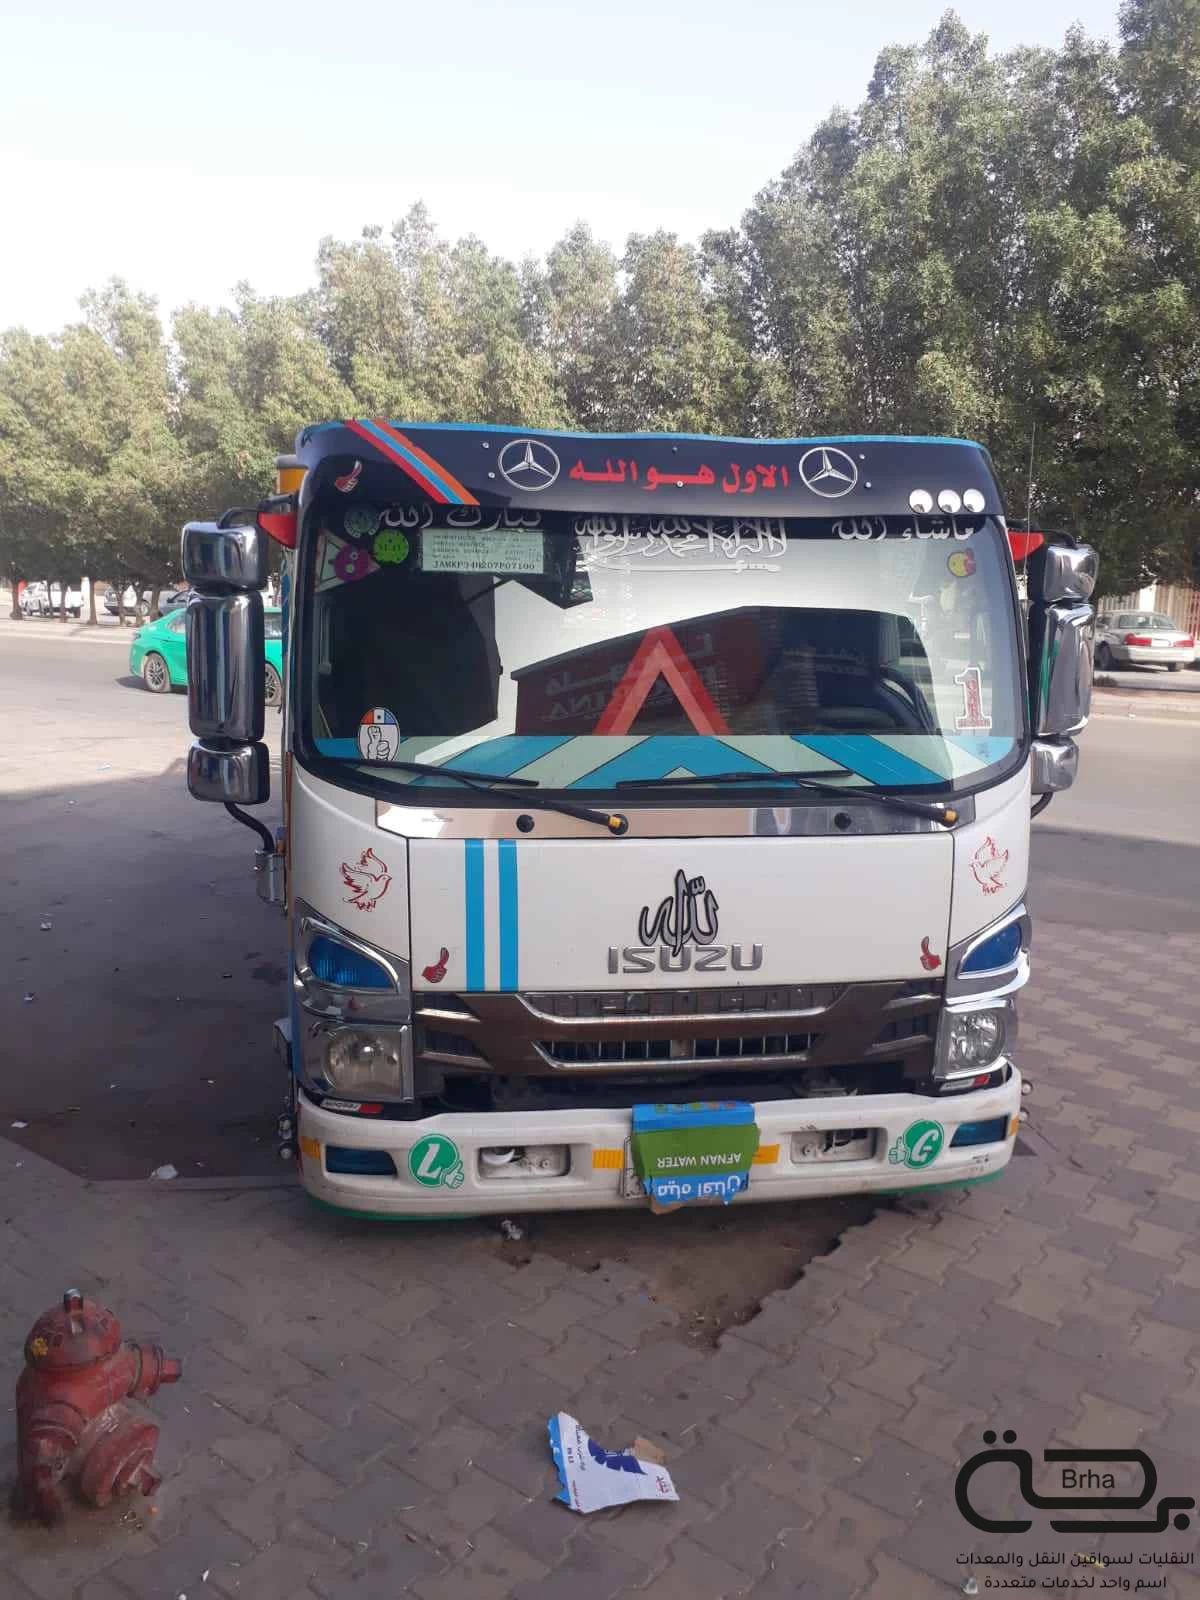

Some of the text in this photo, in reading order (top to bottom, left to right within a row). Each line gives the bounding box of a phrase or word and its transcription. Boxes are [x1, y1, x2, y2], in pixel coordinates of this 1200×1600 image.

[569, 459, 637, 482] الله
[722, 463, 789, 494] الاول
[608, 943, 764, 974] ISUZU
[656, 1152, 742, 1169] AFNAN WATER
[657, 1179, 692, 1200] مياه
